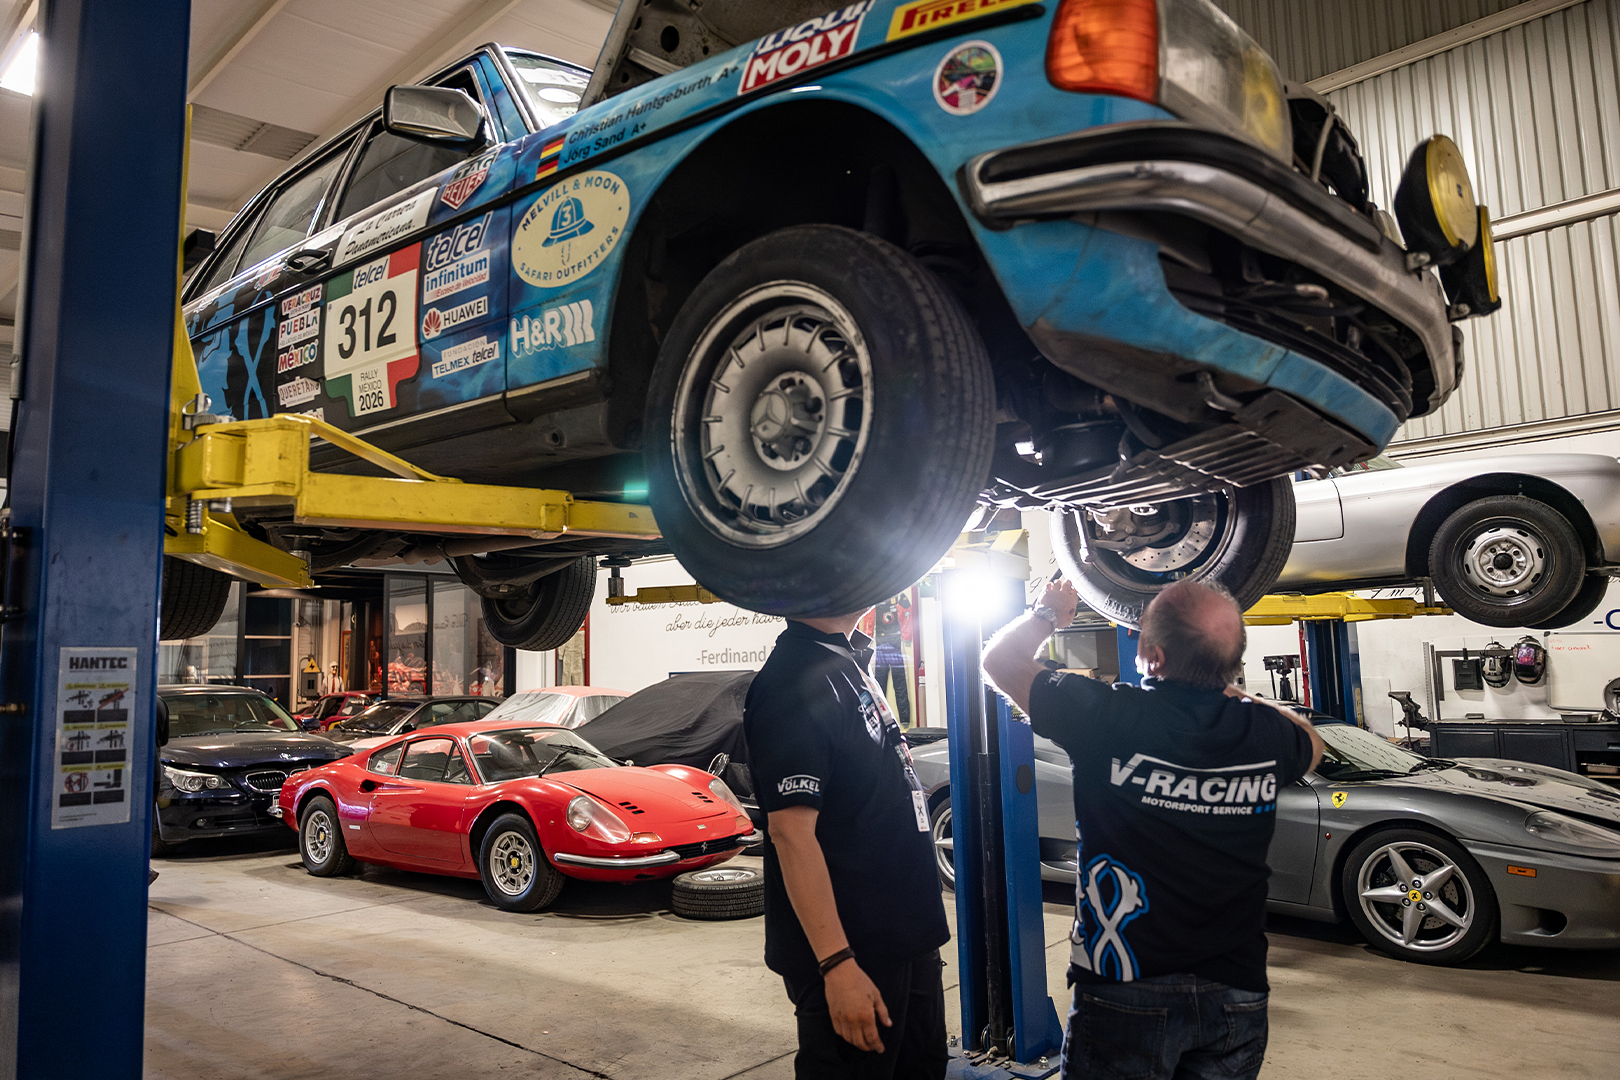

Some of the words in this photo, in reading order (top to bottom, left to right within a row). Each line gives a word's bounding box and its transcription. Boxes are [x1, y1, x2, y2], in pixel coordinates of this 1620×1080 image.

[901, 0, 1013, 31] PIREL
[746, 22, 857, 88] MOLY
[569, 115, 623, 144] Christian
[717, 66, 739, 81] A+
[594, 127, 626, 151] Sand
[631, 122, 647, 136] A+
[455, 154, 495, 180] TAG
[444, 172, 485, 203] HEUER
[522, 184, 569, 231] MELVILL
[573, 179, 581, 190] &
[584, 176, 621, 195] MOON
[561, 205, 572, 227] 3
[427, 211, 493, 270] telcel
[520, 262, 552, 280] SAFARI
[556, 226, 619, 280] OUTFITTERS
[354, 259, 389, 289] telcel
[426, 257, 487, 292] infinitum
[283, 288, 321, 312] VERACRUZ
[444, 299, 487, 326] HUAWEI
[280, 312, 318, 338] PUEBLA
[338, 290, 397, 359] 312
[511, 310, 563, 352] H&R
[434, 356, 470, 375] TELMEX
[472, 343, 496, 363] telcel
[360, 369, 378, 382] RALLY
[359, 390, 384, 411] 2026
[665, 613, 692, 631] aber
[694, 611, 714, 629] die
[708, 607, 751, 637] jeder
[69, 657, 128, 669] HANTEC
[697, 645, 767, 665] -Ferdinand
[777, 777, 820, 793] VÖLKEL
[1110, 753, 1277, 803] V-RACING
[1141, 796, 1211, 814] MOTORSPORT
[1212, 805, 1253, 815] SERVICE
